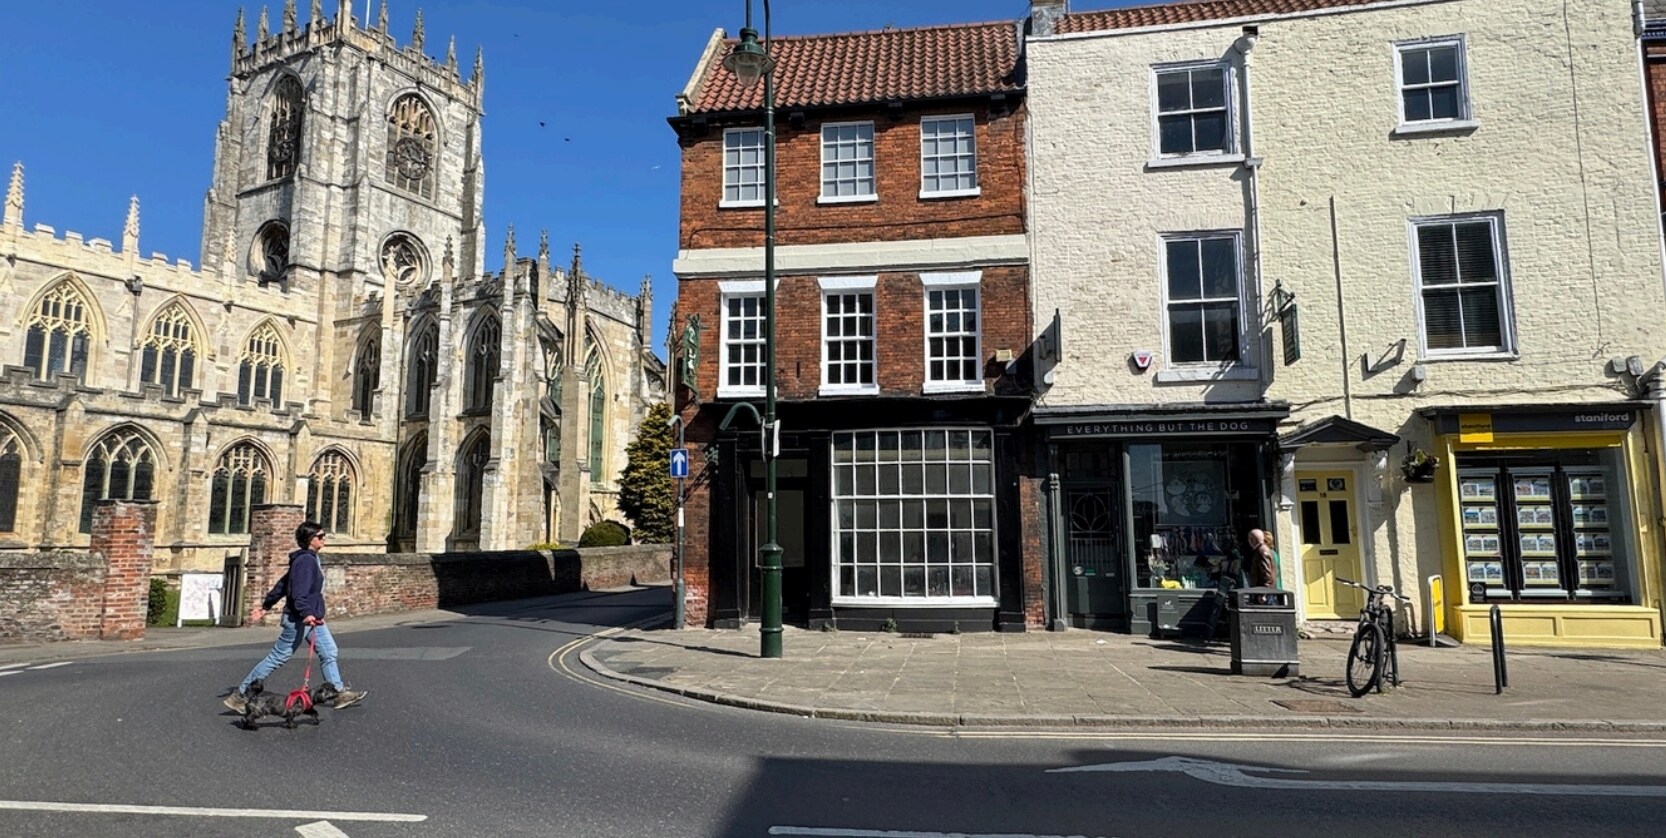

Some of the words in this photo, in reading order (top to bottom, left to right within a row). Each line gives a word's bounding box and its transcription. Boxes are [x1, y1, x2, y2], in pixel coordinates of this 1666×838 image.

[1574, 412, 1629, 422] staniford
[1067, 424, 1152, 435] EVERYTHING
[1158, 423, 1184, 432] BUT
[1189, 422, 1214, 431] THE
[1220, 421, 1248, 430] DOG
[1255, 625, 1282, 634] LITTER
